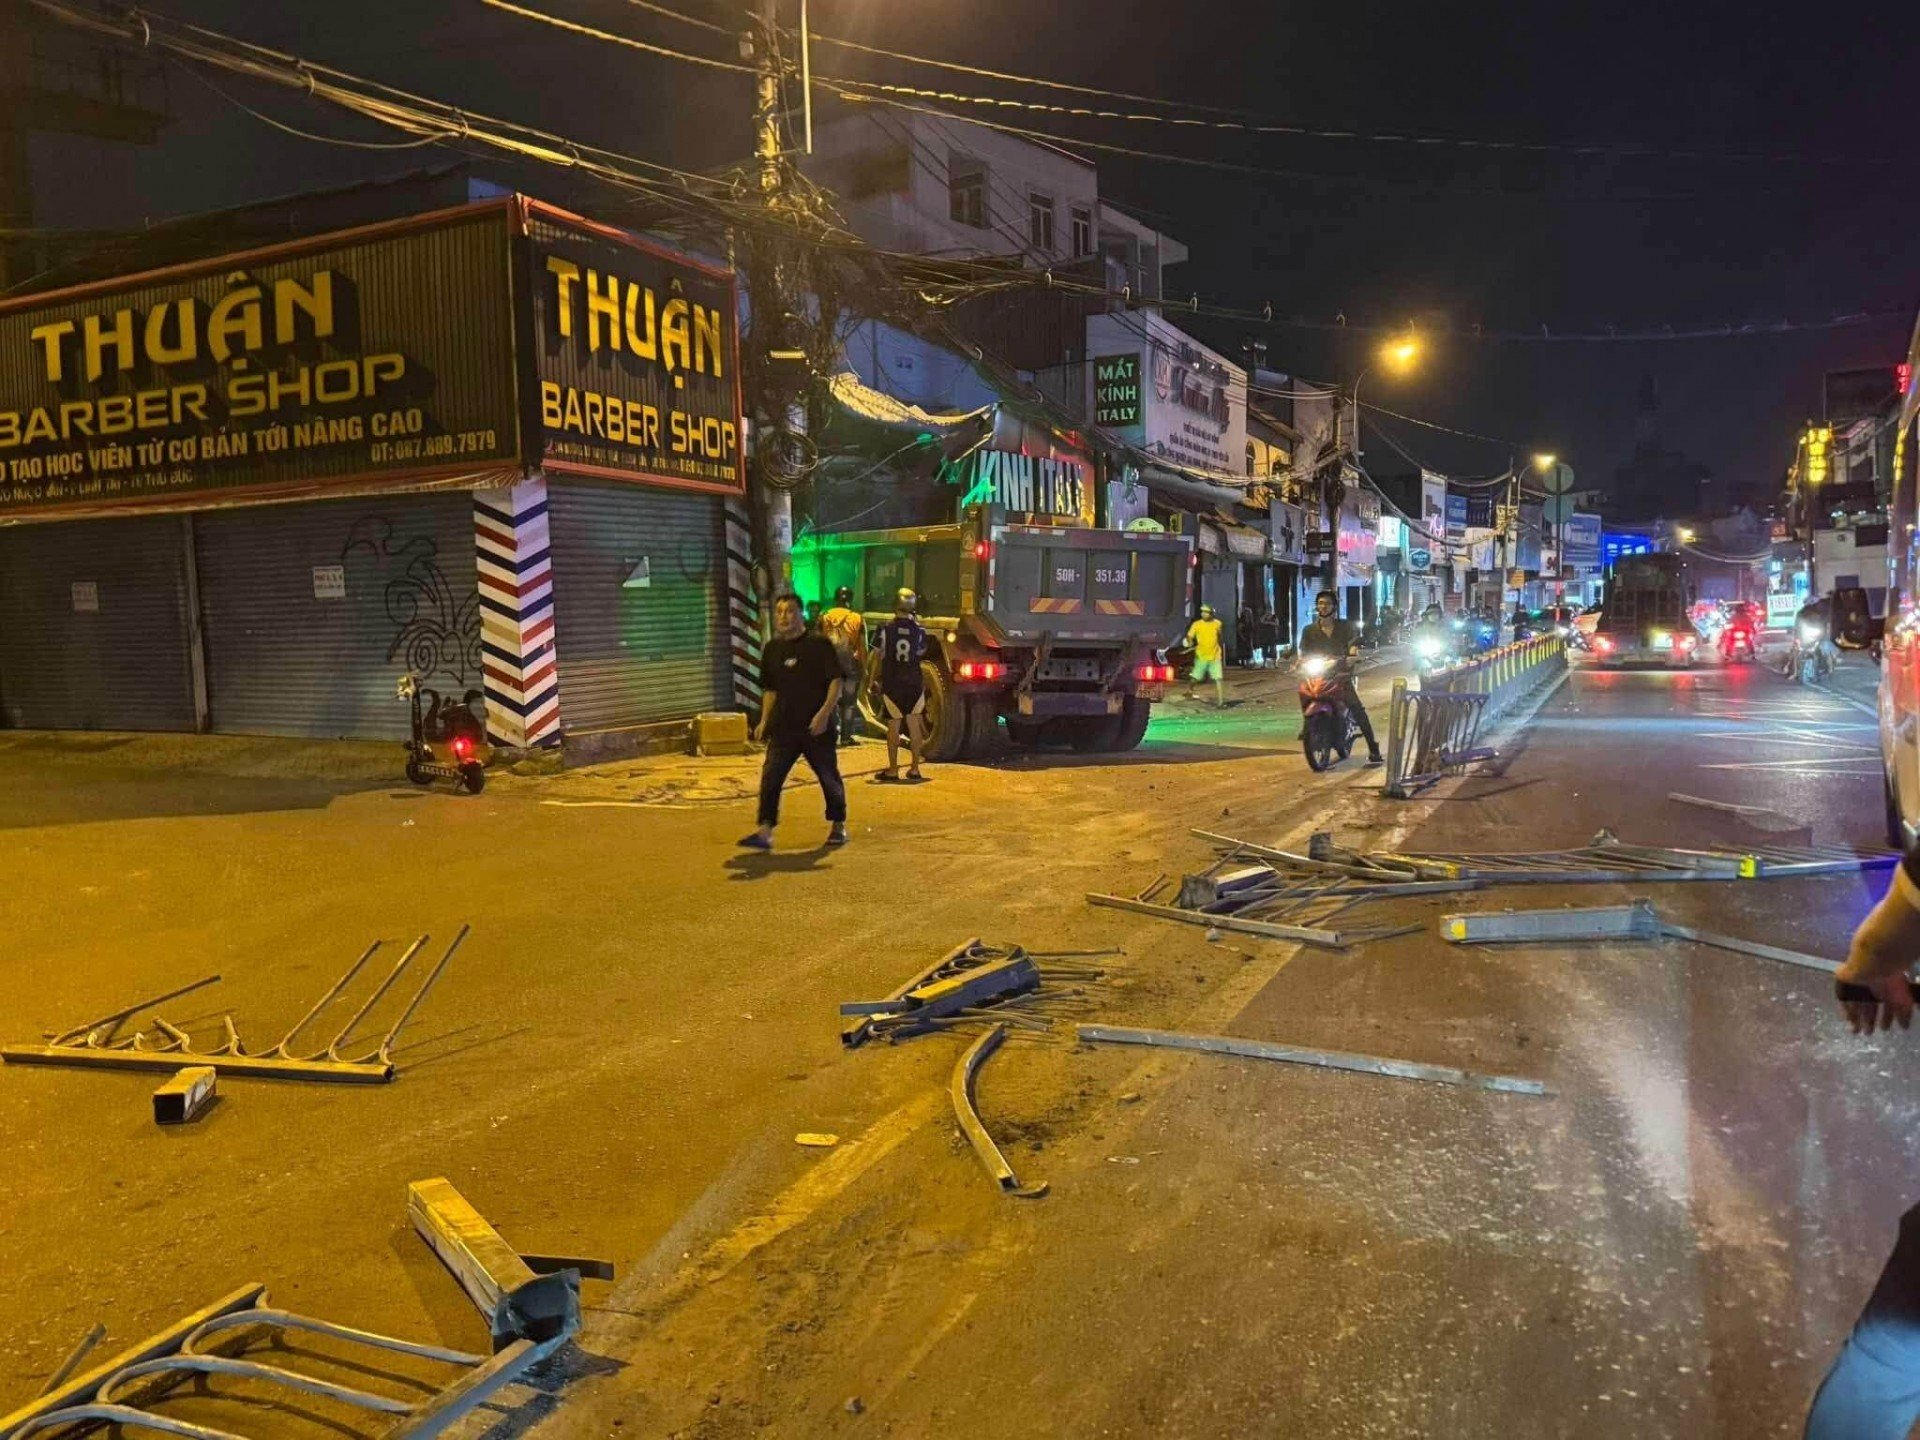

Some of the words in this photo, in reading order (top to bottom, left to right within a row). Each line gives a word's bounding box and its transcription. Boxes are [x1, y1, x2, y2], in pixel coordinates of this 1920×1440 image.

[31, 270, 333, 383] THUẬN
[546, 255, 722, 389] THUẬN
[0, 384, 209, 448] BARBER
[228, 353, 405, 416] SHOP
[541, 380, 660, 449] BARBER
[671, 410, 737, 460] SHOP
[1097, 384, 1136, 403] KÍNH
[1097, 407, 1136, 422] ITALY
[10, 457, 42, 484] TẠO
[46, 452, 84, 481] HỌC
[89, 442, 133, 472] VIÊN
[136, 437, 164, 466] TỪ
[168, 435, 197, 461] CƠ
[201, 425, 248, 459] BẢN
[253, 421, 288, 452] TỚI
[293, 416, 364, 448] NÂNG
[371, 408, 422, 436] CAO
[1095, 569, 1127, 583] 351.39
[895, 638, 911, 663] 8
